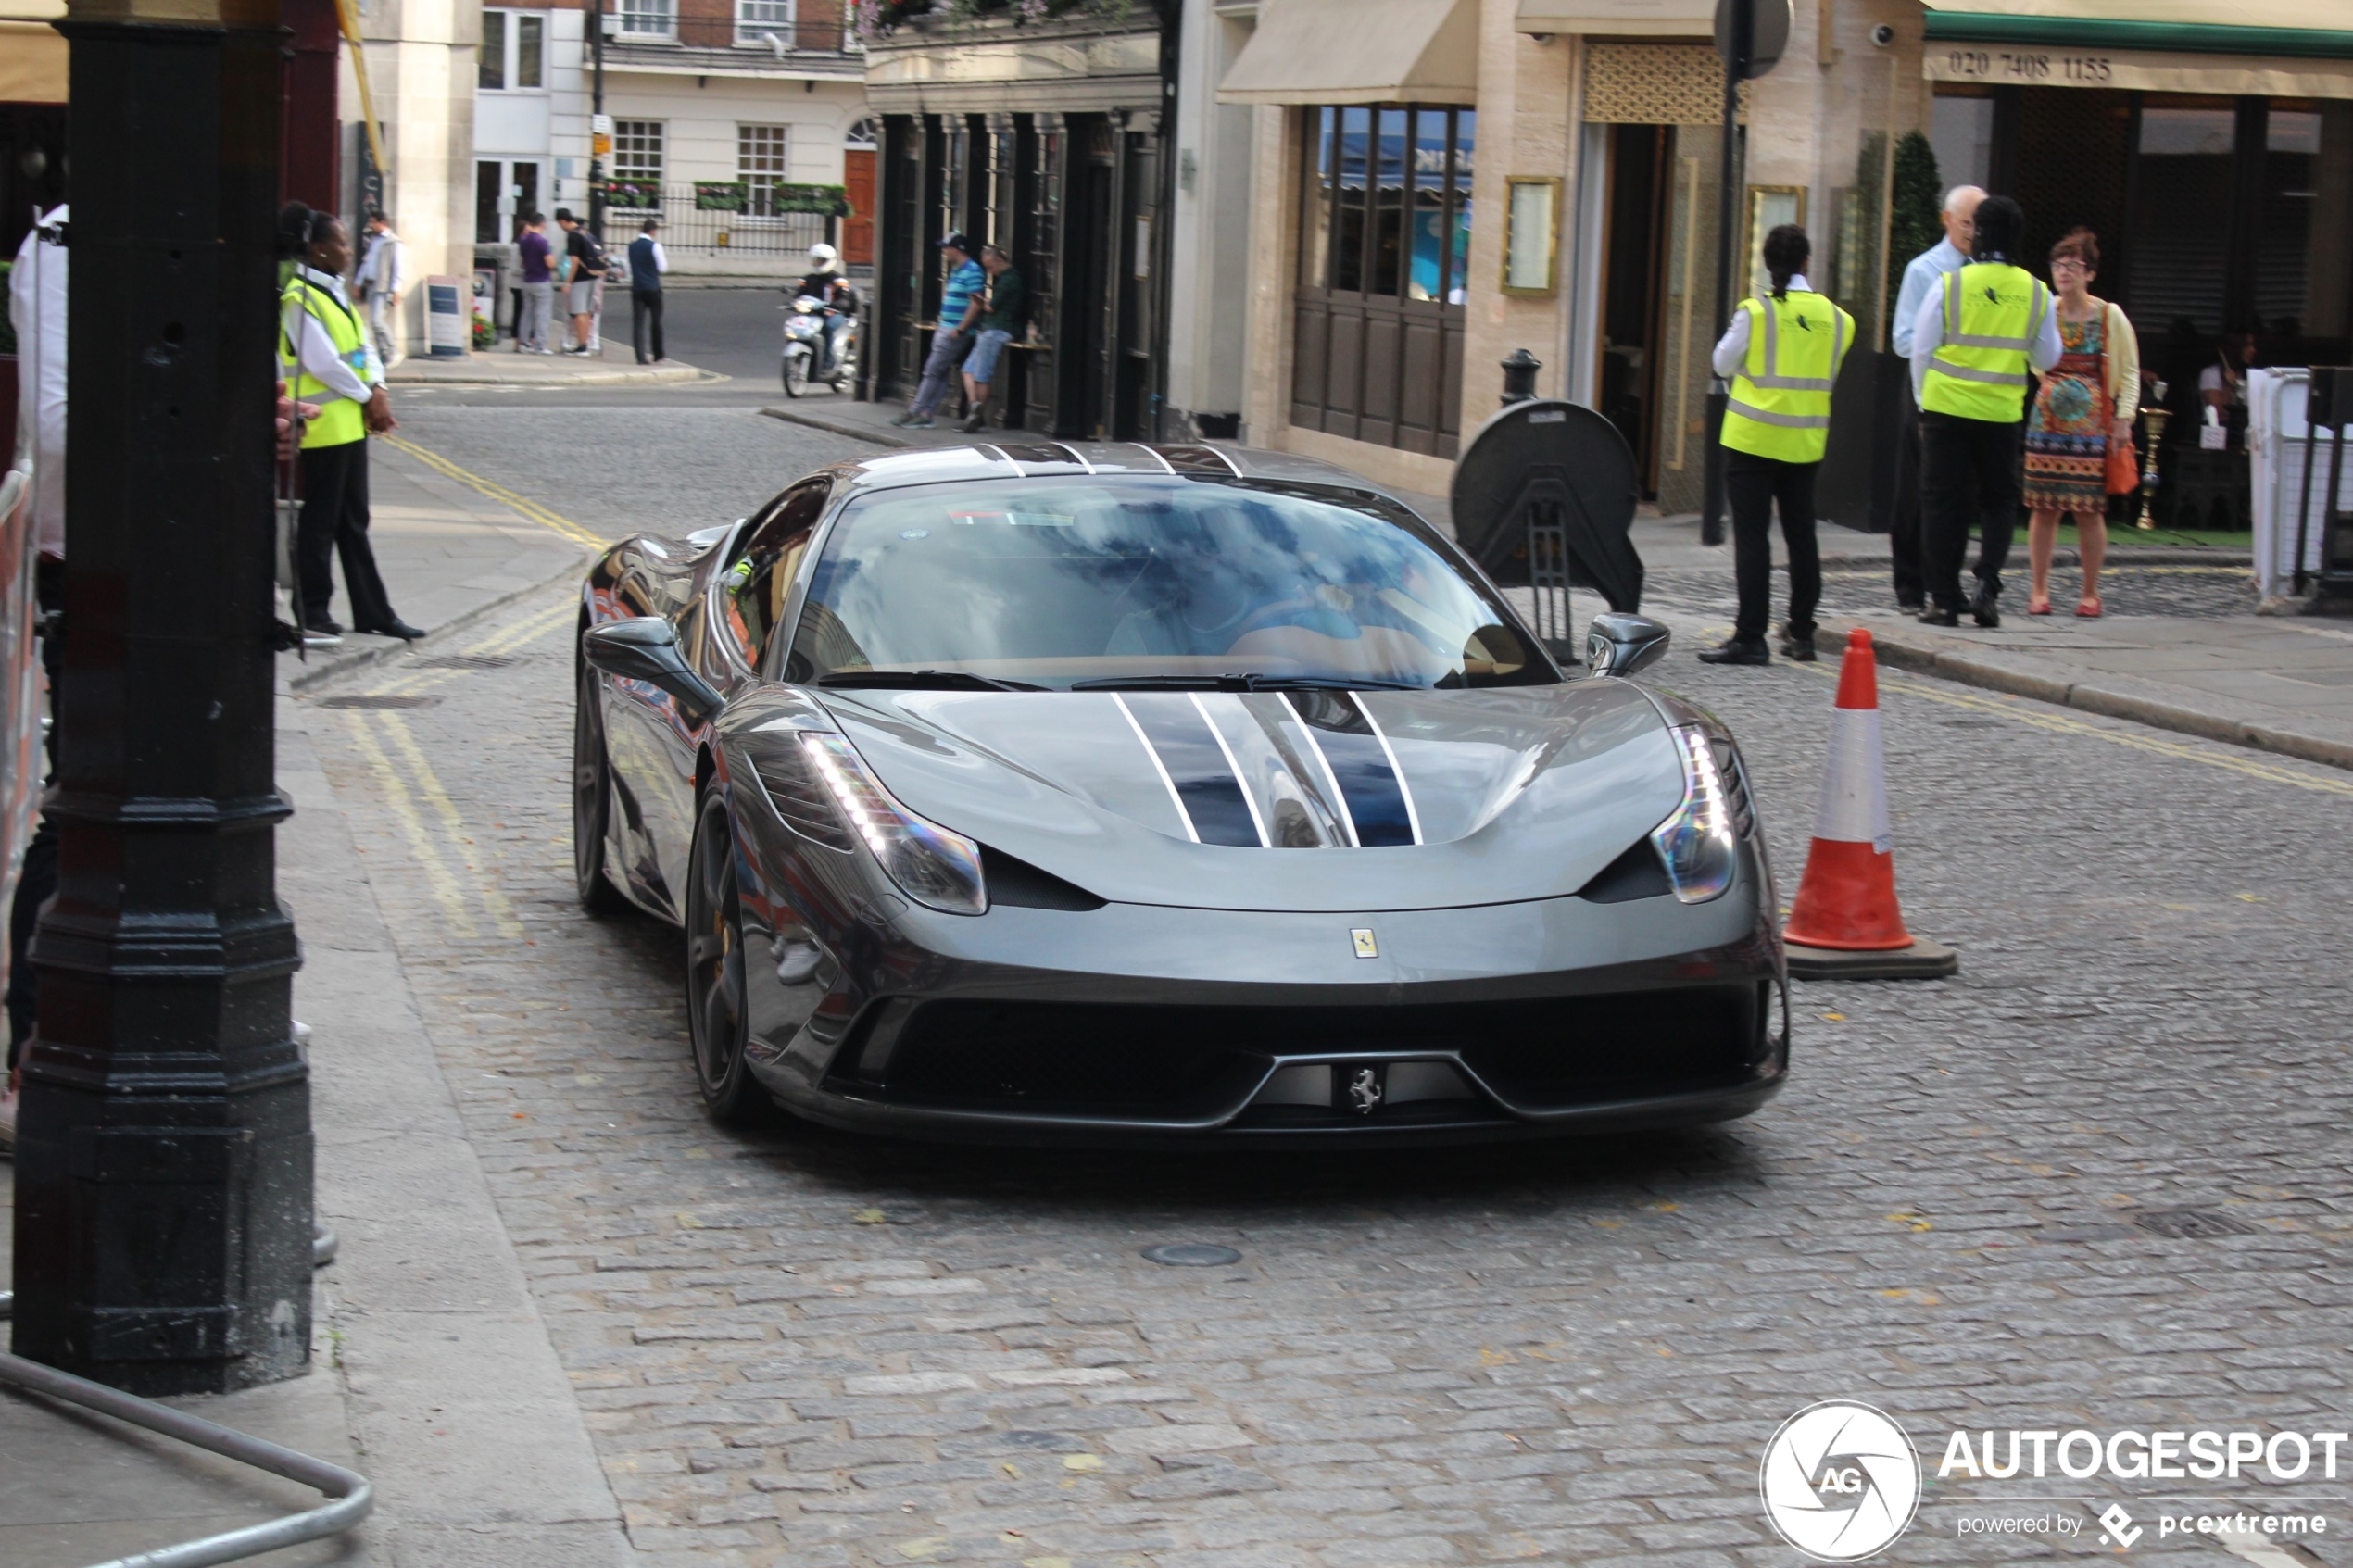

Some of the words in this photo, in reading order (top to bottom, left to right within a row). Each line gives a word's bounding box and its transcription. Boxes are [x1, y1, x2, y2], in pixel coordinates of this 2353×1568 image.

[1949, 50, 1990, 76] 020
[1999, 52, 2051, 78] 7408
[2062, 56, 2112, 82] 1155
